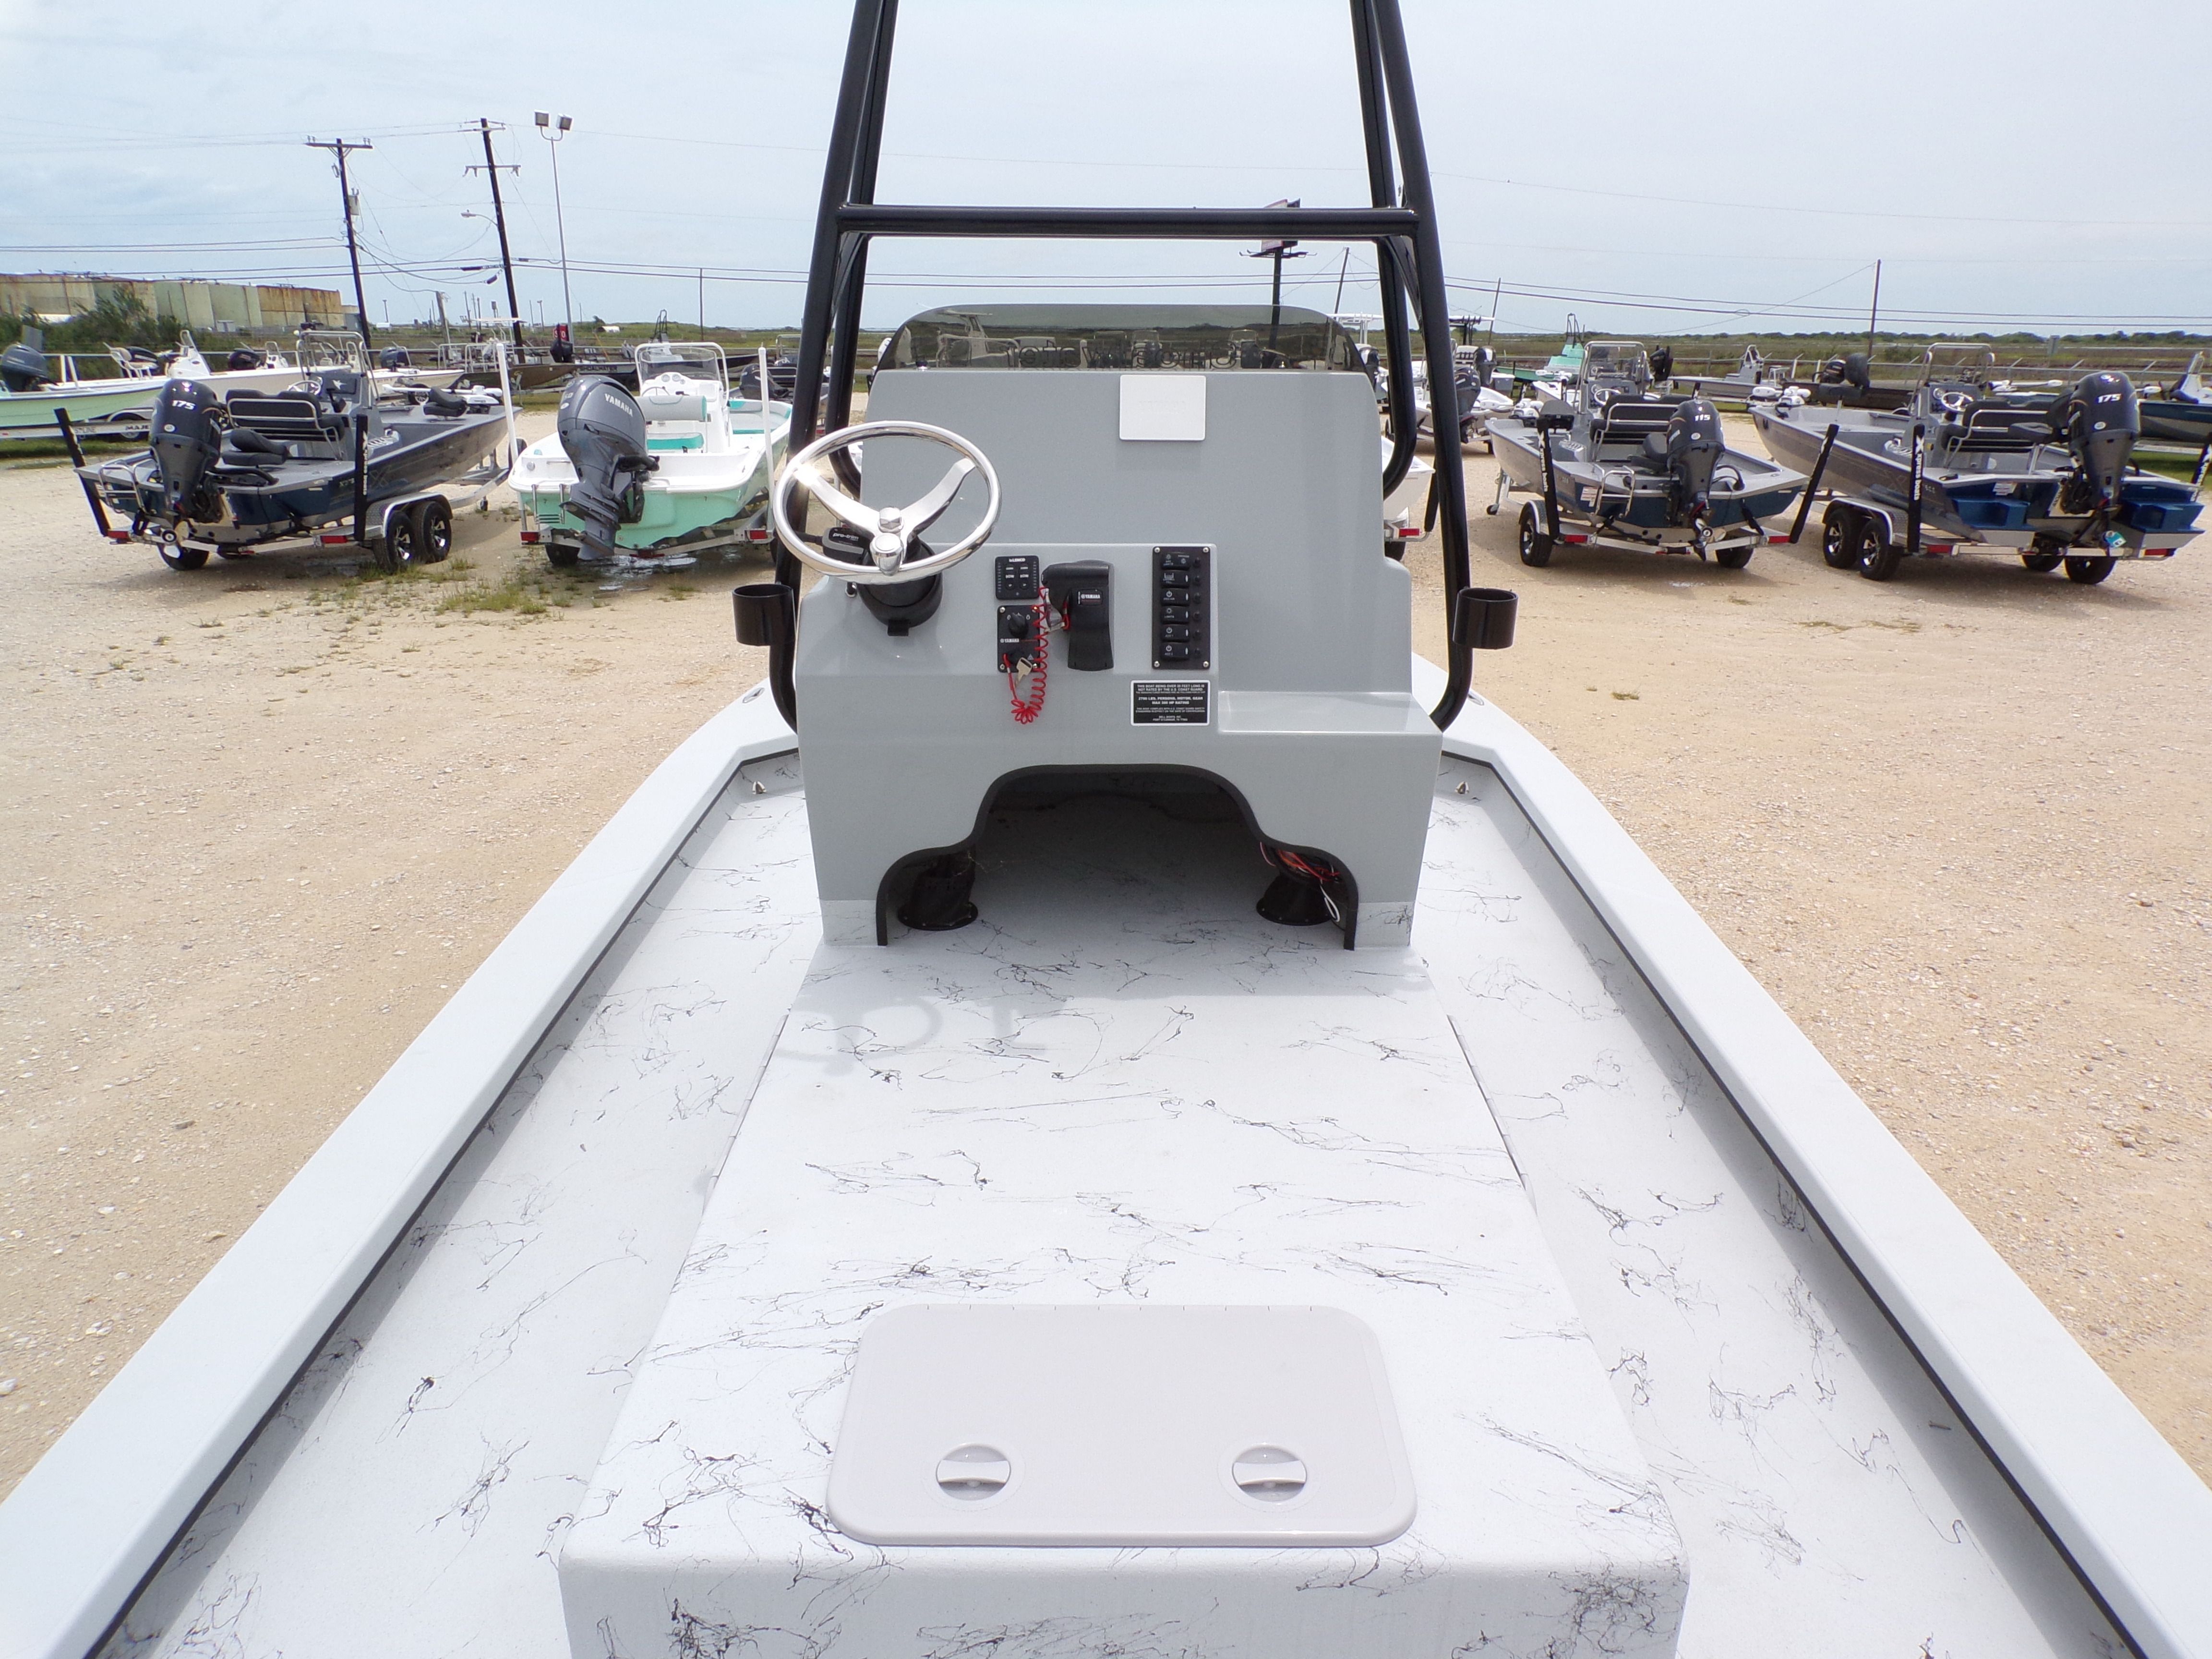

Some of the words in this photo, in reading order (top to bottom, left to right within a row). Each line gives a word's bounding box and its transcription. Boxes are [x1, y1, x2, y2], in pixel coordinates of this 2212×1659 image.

[172, 399, 196, 410] 175
[604, 393, 633, 418] YAMAHA
[2097, 394, 2122, 404] 175
[1913, 480, 1922, 501] boats
